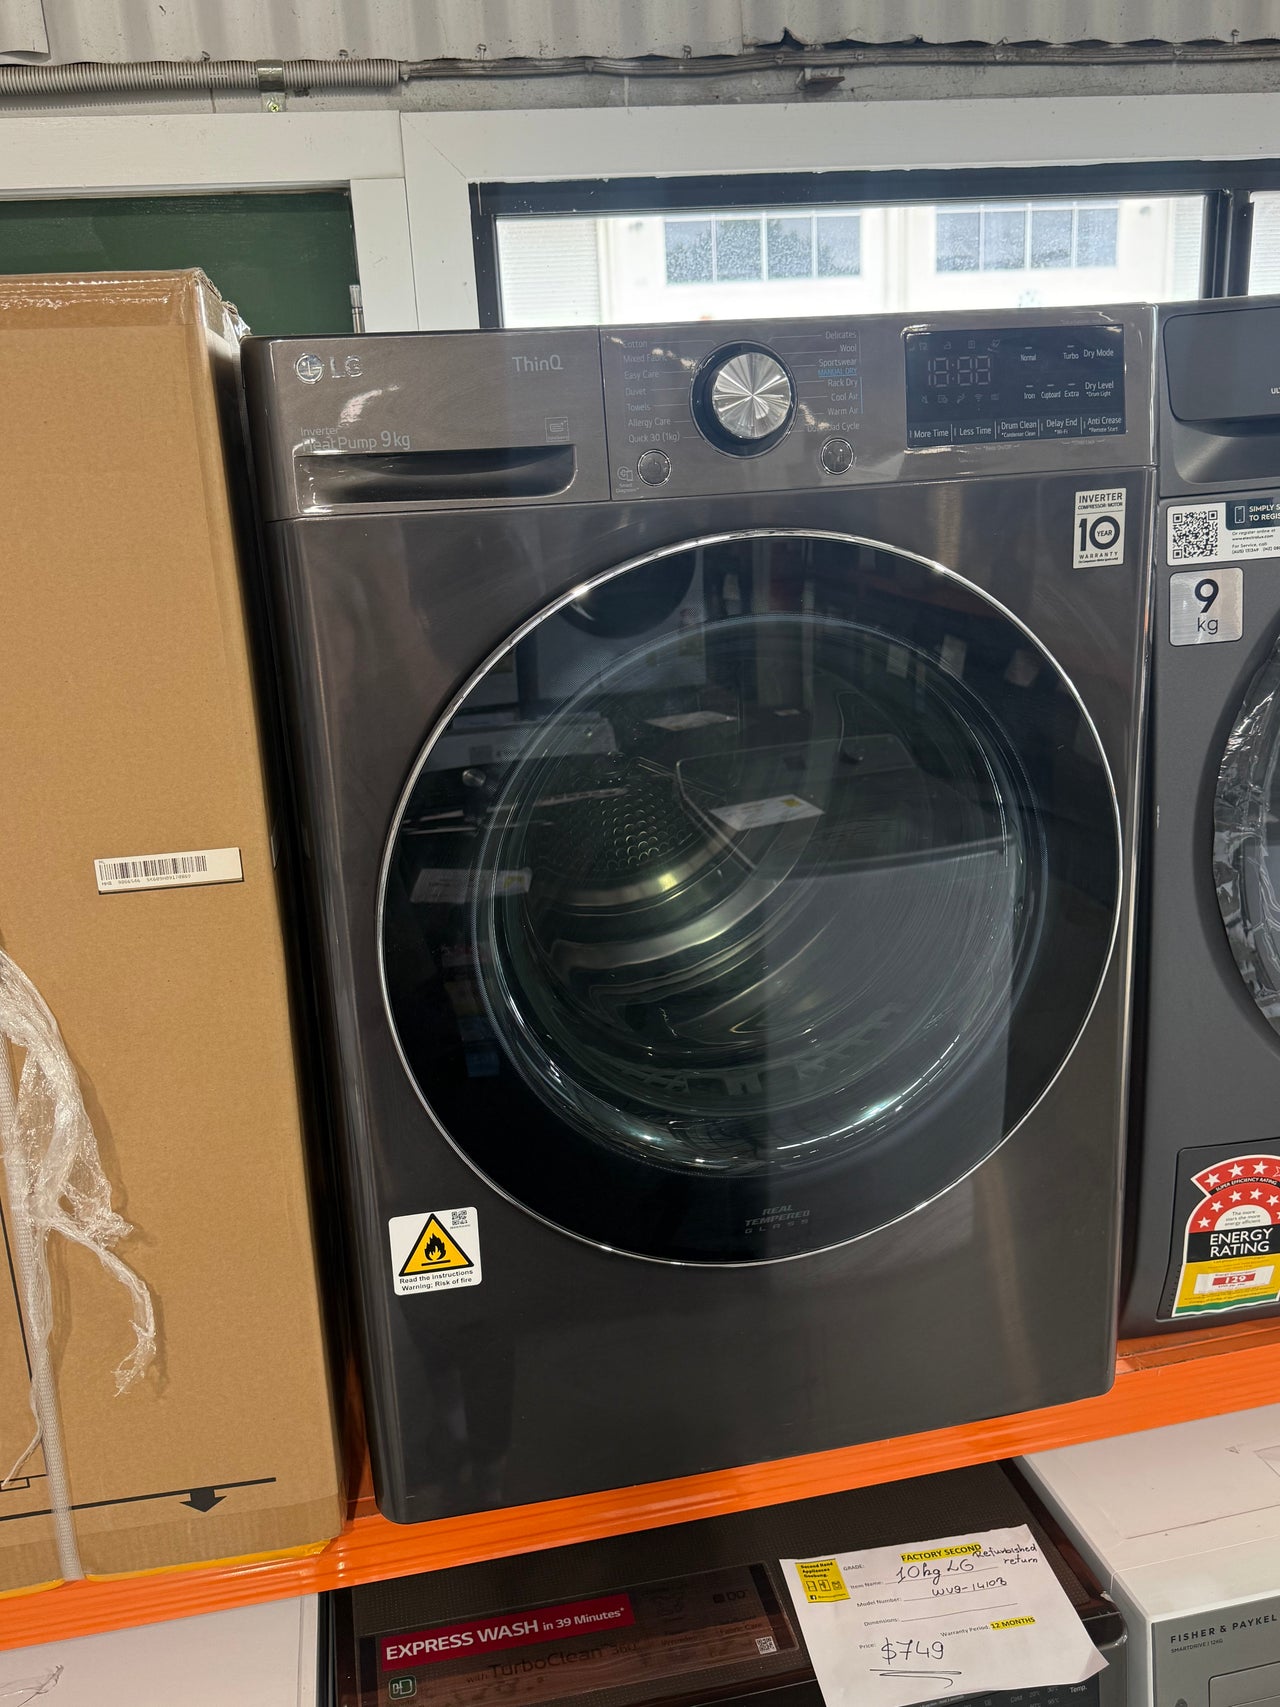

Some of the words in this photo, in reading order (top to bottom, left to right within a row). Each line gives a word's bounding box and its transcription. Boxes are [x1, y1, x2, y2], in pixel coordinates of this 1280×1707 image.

[826, 331, 856, 340] Delicates
[623, 340, 647, 348] Cotton
[840, 344, 856, 352] Wool
[1064, 352, 1079, 360] Turbo
[1084, 349, 1094, 358] Dry
[1096, 348, 1114, 357] Mode
[330, 355, 363, 378] LG
[512, 354, 564, 374] ThinQ
[818, 358, 856, 368] Sportswear
[624, 371, 640, 380] Easy
[643, 370, 659, 378] Care
[828, 379, 844, 387] Rack
[846, 378, 858, 388] Dry
[1085, 382, 1096, 391] Dry
[1098, 380, 1114, 390] Level
[626, 388, 646, 396] Duvet
[831, 394, 846, 402] Cool
[848, 392, 858, 400] Air
[1024, 392, 1036, 400] Iron
[1041, 391, 1061, 399] Cupboard
[1064, 390, 1080, 398] Extra
[627, 404, 650, 412] Towels
[828, 408, 847, 416] Warm
[848, 406, 858, 414] Air
[628, 418, 652, 428] Allergy
[1001, 421, 1018, 430] Drum
[1019, 420, 1037, 429] Clean
[1046, 418, 1064, 428] Delay
[1064, 418, 1078, 427] End
[1088, 416, 1100, 425] Anti
[1102, 416, 1122, 425] Crease
[300, 426, 338, 436] Inverter
[842, 423, 860, 432] Cycle
[959, 426, 974, 436] Less
[975, 426, 992, 435] Time
[628, 434, 648, 444] Quick
[650, 433, 660, 442] 30
[662, 432, 680, 442] (1kg)
[914, 430, 931, 438] More
[932, 428, 949, 437] Time
[338, 437, 377, 450] Pump
[1078, 492, 1123, 504] INVERTER
[1249, 504, 1275, 512] SIMPLY
[1249, 514, 1260, 522] TO
[1079, 516, 1120, 552] 10
[1079, 552, 1118, 560] WARRANTY
[1194, 578, 1220, 614] 9
[1197, 617, 1218, 635] kg
[1216, 1182, 1230, 1192] SUPER
[1231, 1177, 1259, 1186] EFFICIENCY
[1259, 1178, 1278, 1186] RATING
[762, 1204, 793, 1216] REAL
[744, 1210, 810, 1226] TEMPERED
[1210, 1228, 1274, 1246] ENERGY
[1210, 1240, 1270, 1258] RATING
[400, 1276, 418, 1284] Read
[432, 1269, 474, 1280] instructions
[1225, 1276, 1246, 1284] 129
[901, 1550, 942, 1562] FACTORY
[945, 1544, 982, 1556] SECOND
[972, 1543, 1038, 1560] Refurbished
[947, 1558, 974, 1572] LG
[1004, 1554, 1038, 1566] return
[800, 1562, 820, 1570] Second
[843, 1564, 865, 1572] GRADE:
[865, 1580, 884, 1588] Name:
[856, 1600, 876, 1608] Model
[864, 1618, 900, 1627] Dimensions:
[991, 1622, 1000, 1630] 12
[1002, 1616, 1036, 1628] MONTHS
[940, 1628, 968, 1638] Warranty
[1170, 1627, 1216, 1644] FISHER
[1220, 1625, 1227, 1634] &
[1232, 1614, 1278, 1631] PAYKEL
[386, 1632, 474, 1661] EXPRESS
[477, 1619, 539, 1643] WASH
[542, 1622, 554, 1632] in
[556, 1618, 572, 1628] 39
[859, 1642, 876, 1650] Price:
[881, 1637, 944, 1665] $749
[1171, 1641, 1206, 1654] SMARTDRIVE
[466, 1671, 488, 1684] with
[488, 1646, 602, 1678] TurboClean
[1070, 1684, 1088, 1694] Temp.
[1010, 1696, 1023, 1704] Cold
